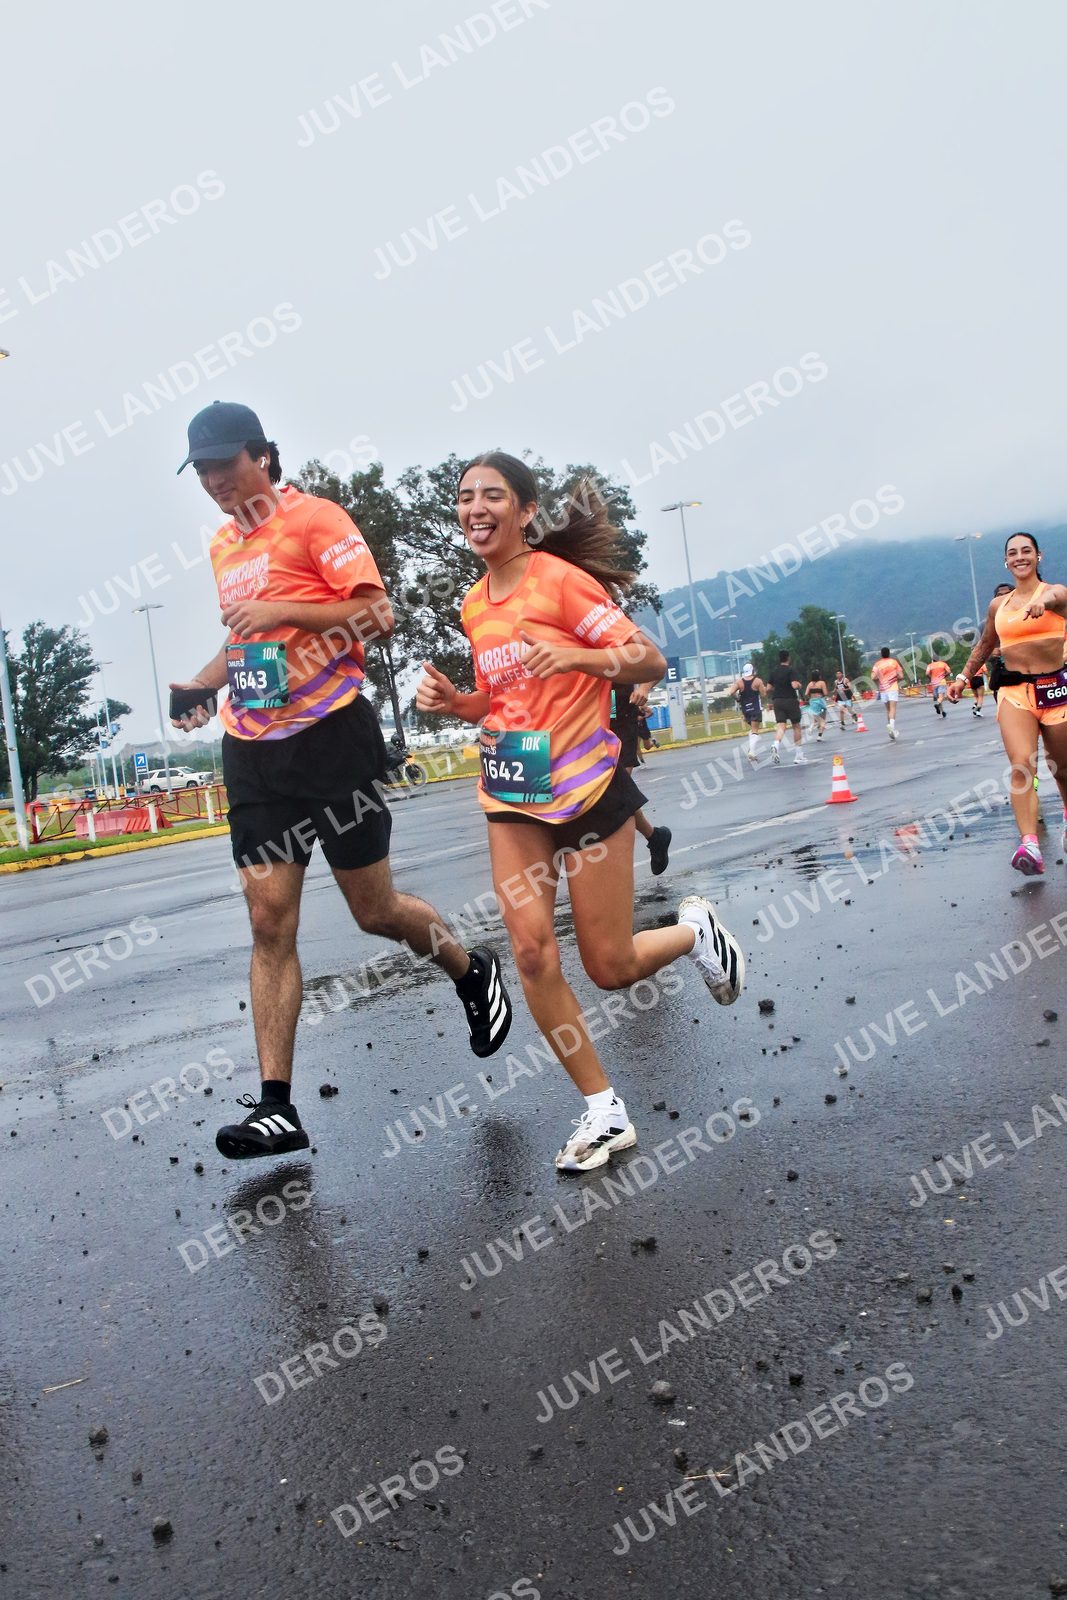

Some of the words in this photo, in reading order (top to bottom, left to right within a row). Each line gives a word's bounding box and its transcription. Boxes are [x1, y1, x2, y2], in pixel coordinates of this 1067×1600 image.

[263, 647, 279, 660] 10K
[234, 670, 268, 690] 1643
[667, 668, 677, 680] E
[521, 736, 540, 751] 10K
[483, 757, 525, 782] 1642
